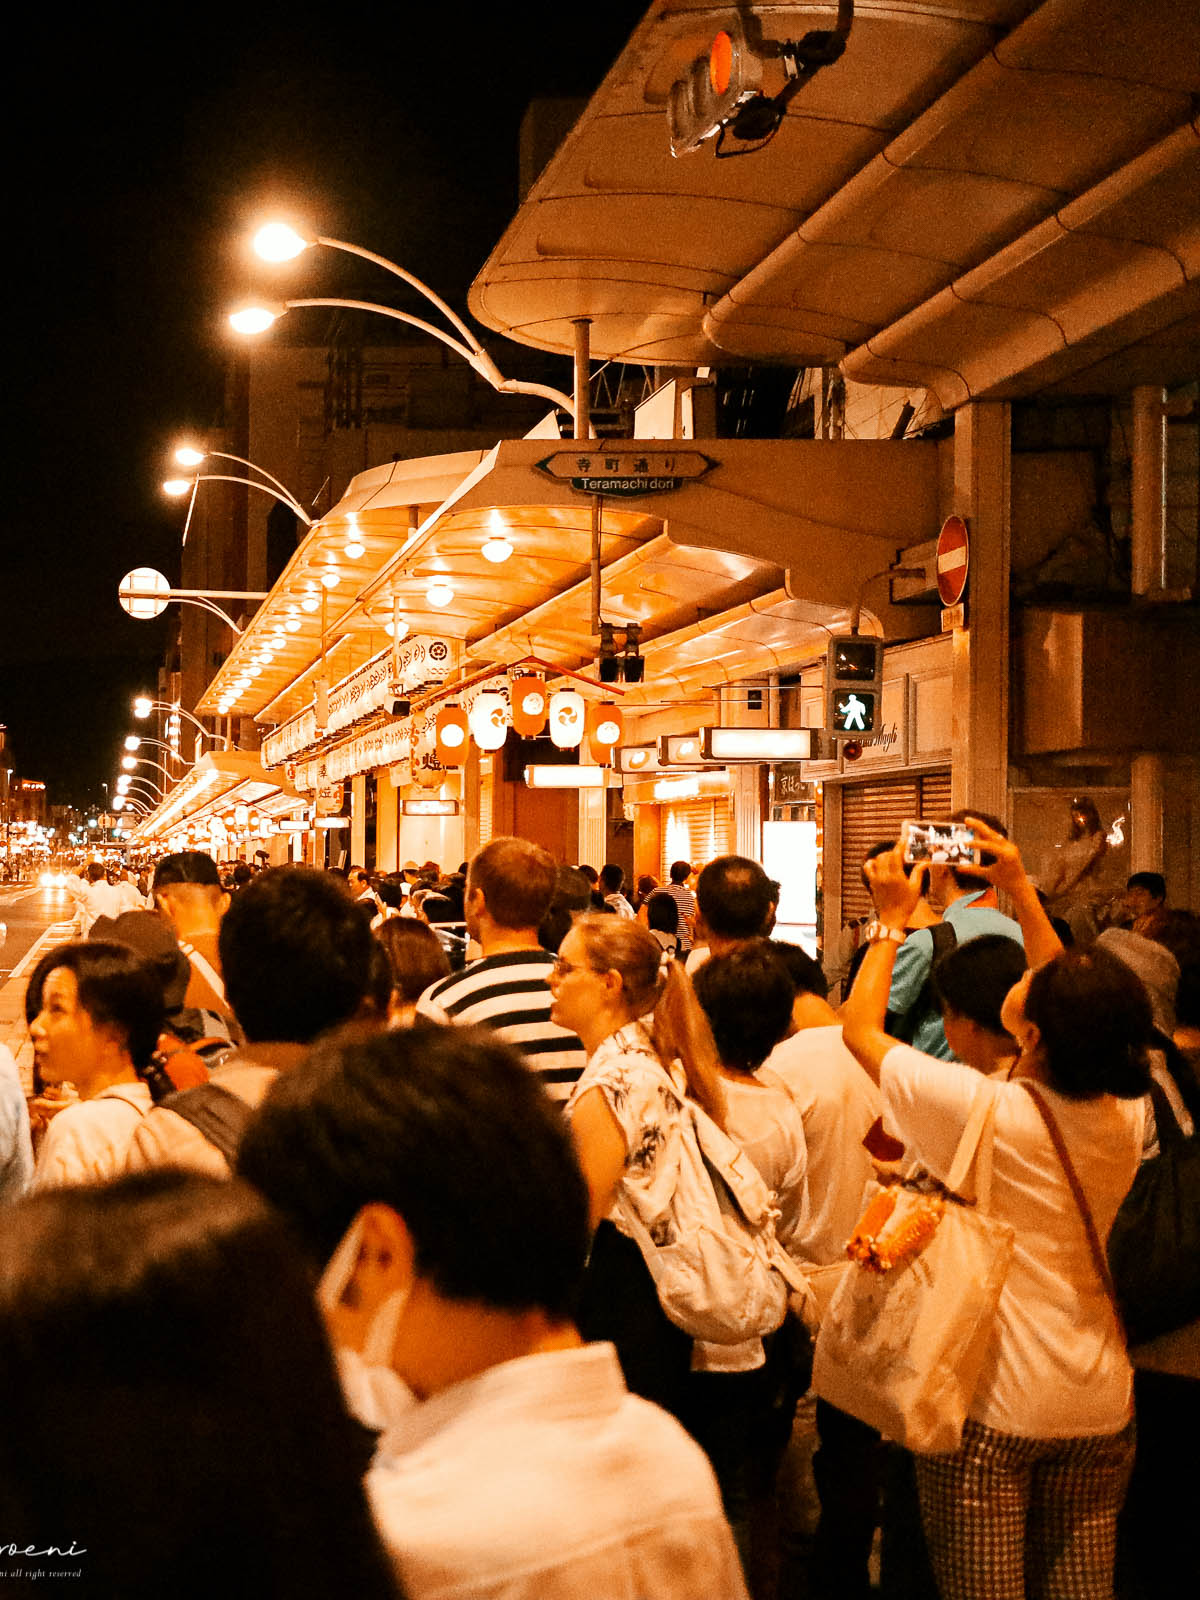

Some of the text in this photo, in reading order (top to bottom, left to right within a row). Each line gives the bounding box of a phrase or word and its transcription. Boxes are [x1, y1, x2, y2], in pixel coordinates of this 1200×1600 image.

[576, 457, 675, 473] 寺町通り
[581, 478, 674, 489] Teramachi dori
